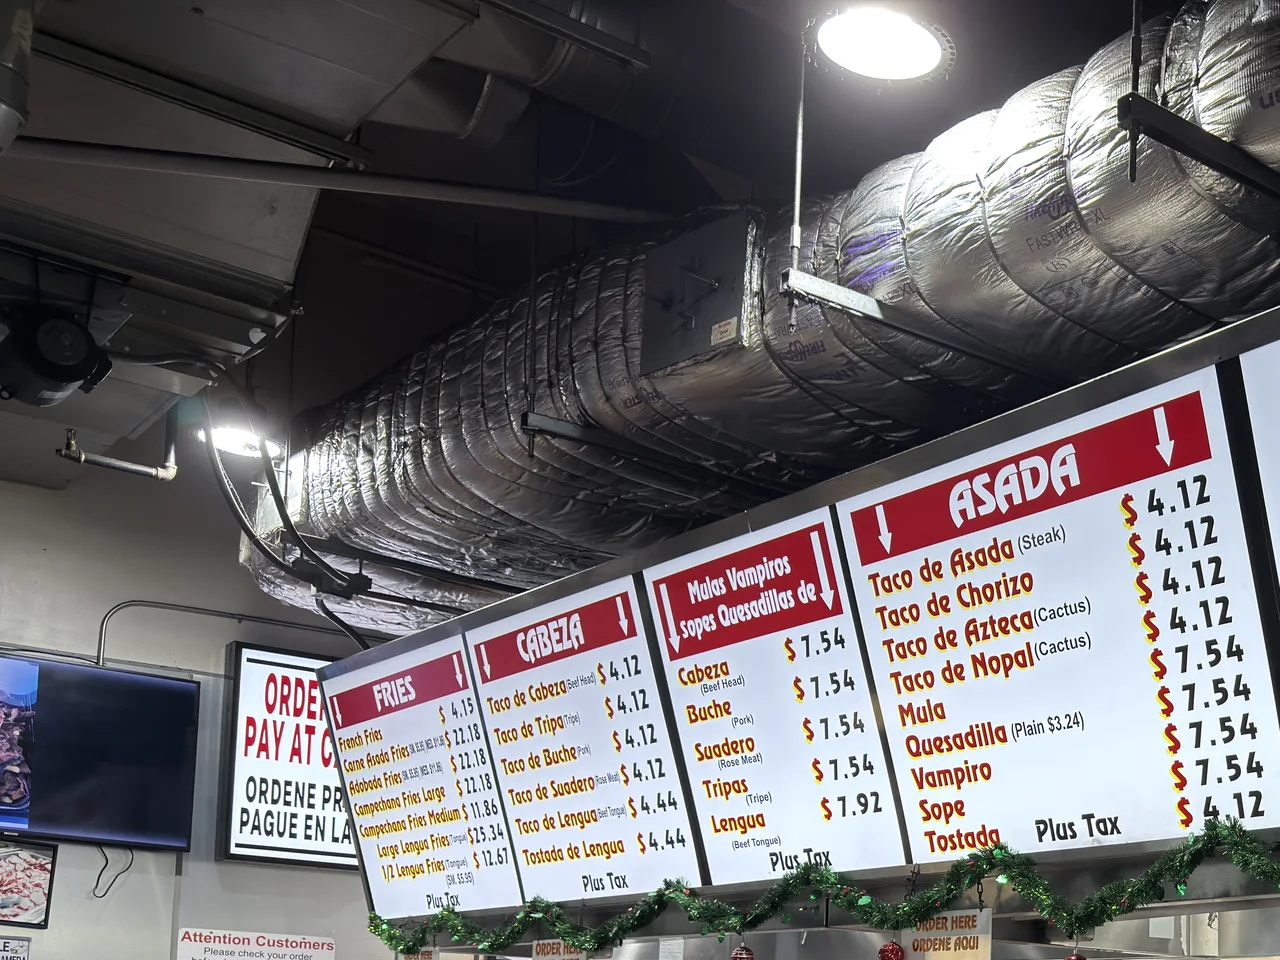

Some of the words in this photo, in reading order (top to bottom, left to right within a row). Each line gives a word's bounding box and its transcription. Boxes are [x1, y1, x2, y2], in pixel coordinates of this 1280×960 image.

[949, 443, 1081, 528] ASADA
[867, 569, 913, 597] Taco
[918, 557, 944, 582] de
[949, 537, 1014, 579] Asada
[1017, 524, 1066, 555] (Steak)
[687, 575, 726, 604] Mulas
[725, 555, 791, 591] Vampiros
[717, 587, 795, 627] Quesadillas
[797, 580, 817, 603] de
[875, 603, 920, 631] Taco
[926, 592, 951, 616] de
[956, 571, 1034, 609] Chorizo
[516, 613, 585, 664] CABEZA
[677, 661, 730, 688] Cabeza
[700, 680, 721, 696] (Beef
[722, 675, 746, 690] Head)
[372, 675, 416, 712] FRIES
[487, 696, 511, 715] Taco
[513, 689, 527, 708] de
[528, 679, 567, 701] Cabeza
[686, 700, 732, 725] Buche
[898, 700, 946, 727] Mula
[244, 716, 285, 761] PAY
[289, 723, 315, 765] AT
[338, 731, 363, 752] French
[363, 728, 383, 746] Fries
[694, 737, 755, 762] Suadero
[905, 722, 1008, 759] Quesadilla
[1011, 722, 1045, 743] (Plain
[1047, 711, 1085, 735] $3.24)
[343, 755, 365, 773] Carne
[366, 751, 390, 768] Asada
[390, 744, 410, 763] Fries
[508, 788, 532, 806] Taco
[535, 783, 549, 800] de
[550, 775, 595, 798] Suadero
[702, 778, 749, 801] Tripas
[911, 761, 992, 792] Vampiro
[245, 775, 316, 809] ORDENE
[239, 807, 298, 839] PAGUE
[304, 814, 326, 842] EN
[359, 818, 406, 839] Campechana
[407, 814, 426, 831] Fries
[427, 806, 461, 825] Medium
[711, 813, 766, 835] Lengua
[918, 799, 965, 827] Sope
[1034, 817, 1077, 843] Plus
[1082, 812, 1122, 837] Tax
[522, 846, 564, 867] Tostada
[566, 843, 580, 860] de
[581, 838, 625, 861] Lengua
[924, 824, 1001, 854] Tostada
[582, 874, 605, 892] Plus
[606, 872, 629, 889] Tax
[915, 915, 948, 933] ORDER
[951, 914, 977, 930] HERE
[181, 930, 250, 946] Attention
[256, 935, 334, 951] Customers
[204, 947, 236, 957] Please
[238, 949, 265, 959] check
[267, 952, 287, 960] your
[289, 952, 313, 960] order
[535, 942, 561, 956] ORDER
[912, 936, 951, 953] ORDENE
[953, 935, 979, 952] AQUI
